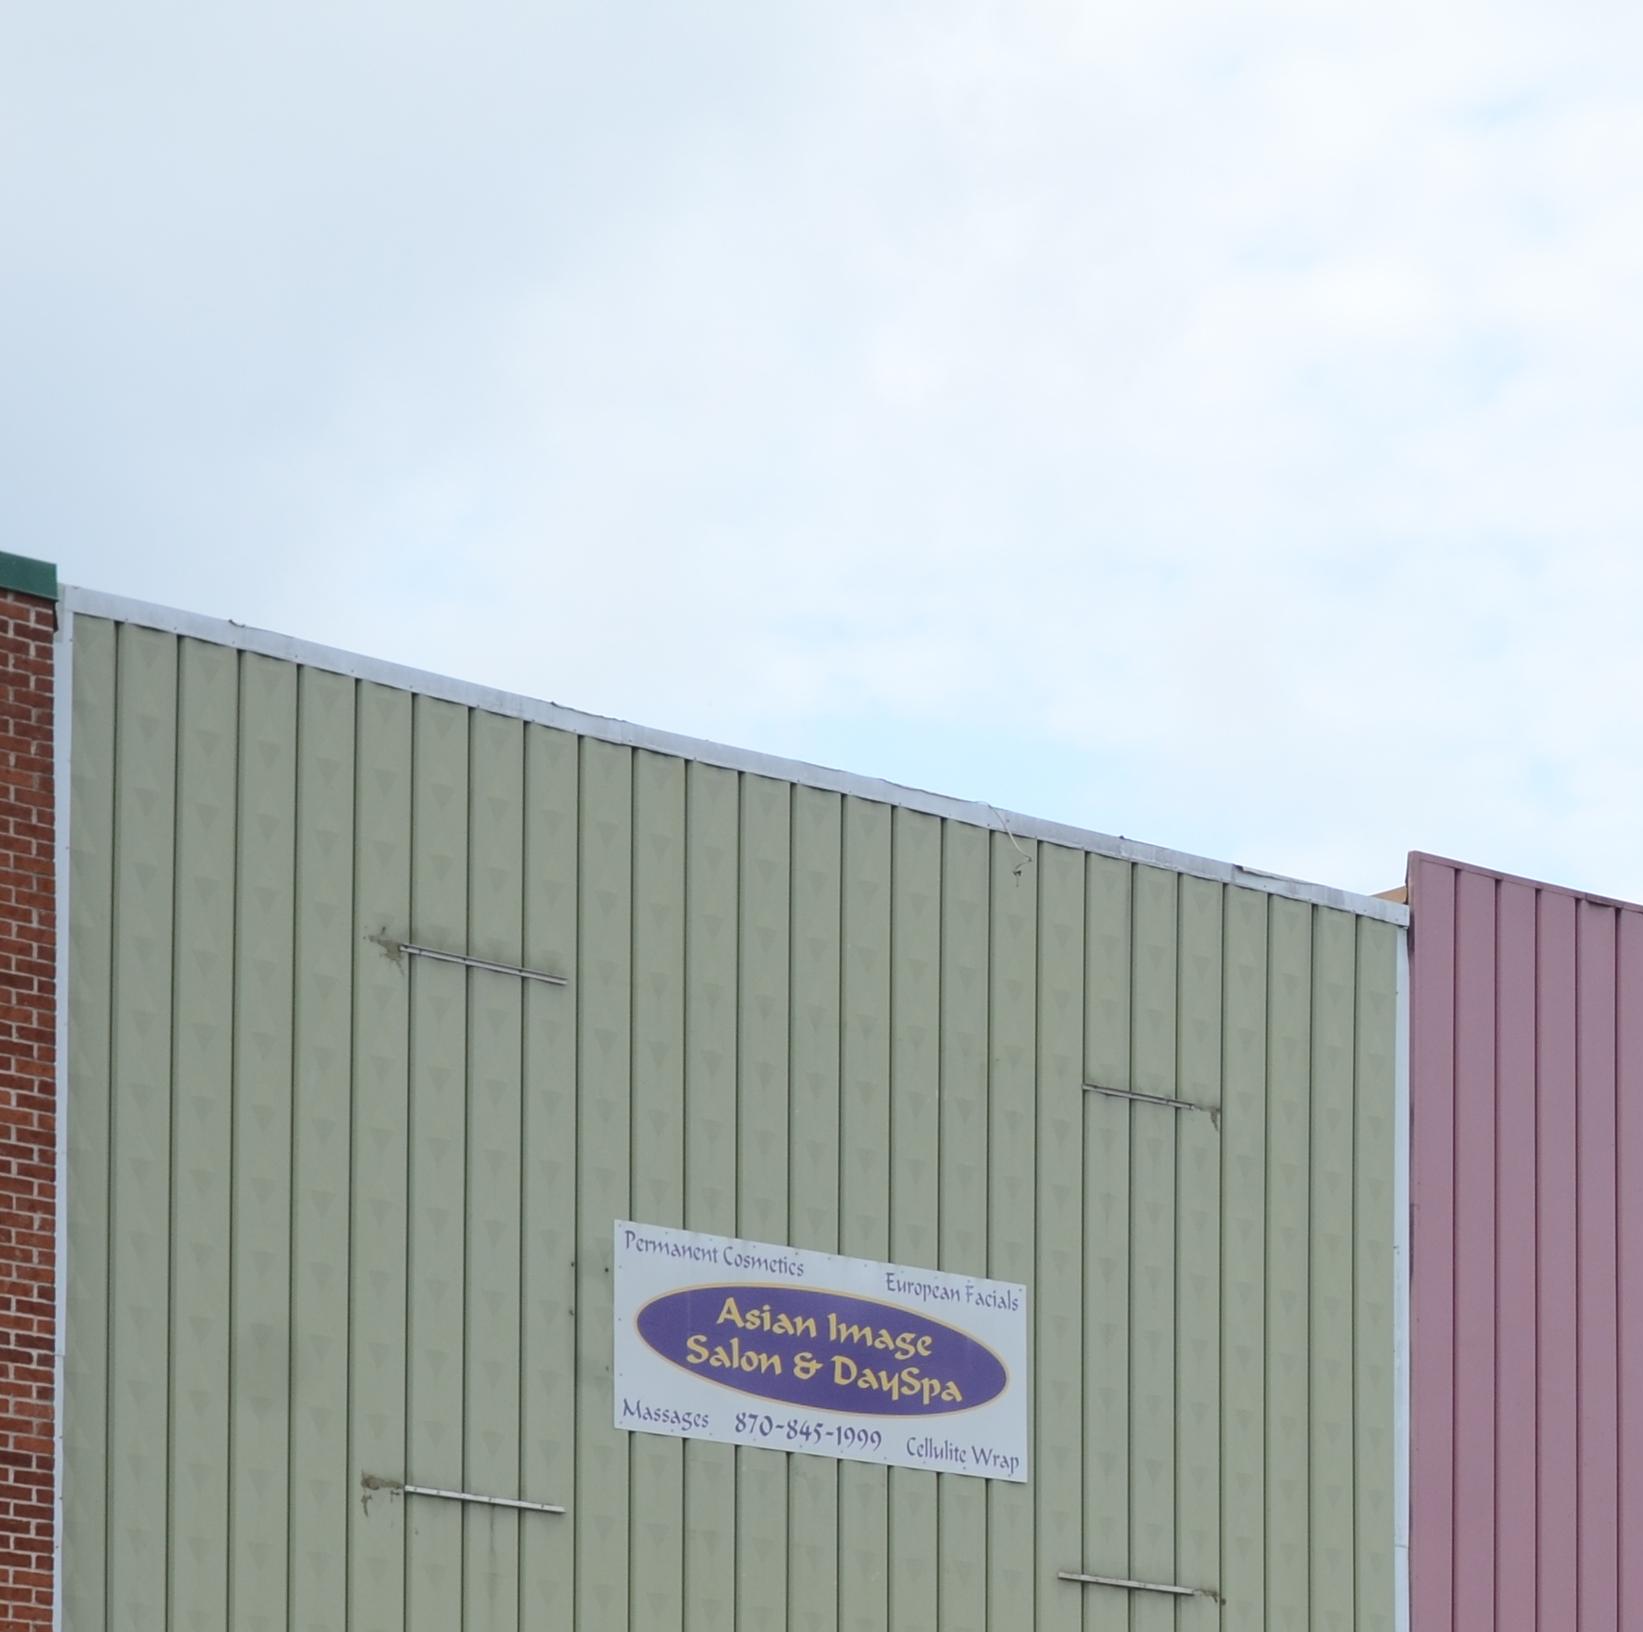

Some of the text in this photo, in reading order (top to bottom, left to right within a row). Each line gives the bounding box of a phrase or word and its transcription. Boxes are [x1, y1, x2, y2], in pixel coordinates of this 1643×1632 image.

[625, 1231, 805, 1278] Permanent Cosmetics
[886, 1272, 1020, 1312] European Facials
[717, 1297, 933, 1361] Asian Image
[686, 1335, 963, 1405] Salon & DaySpa
[622, 1399, 883, 1451] Massages 870-845-1999
[906, 1437, 1020, 1479] Cellulite Wrap
